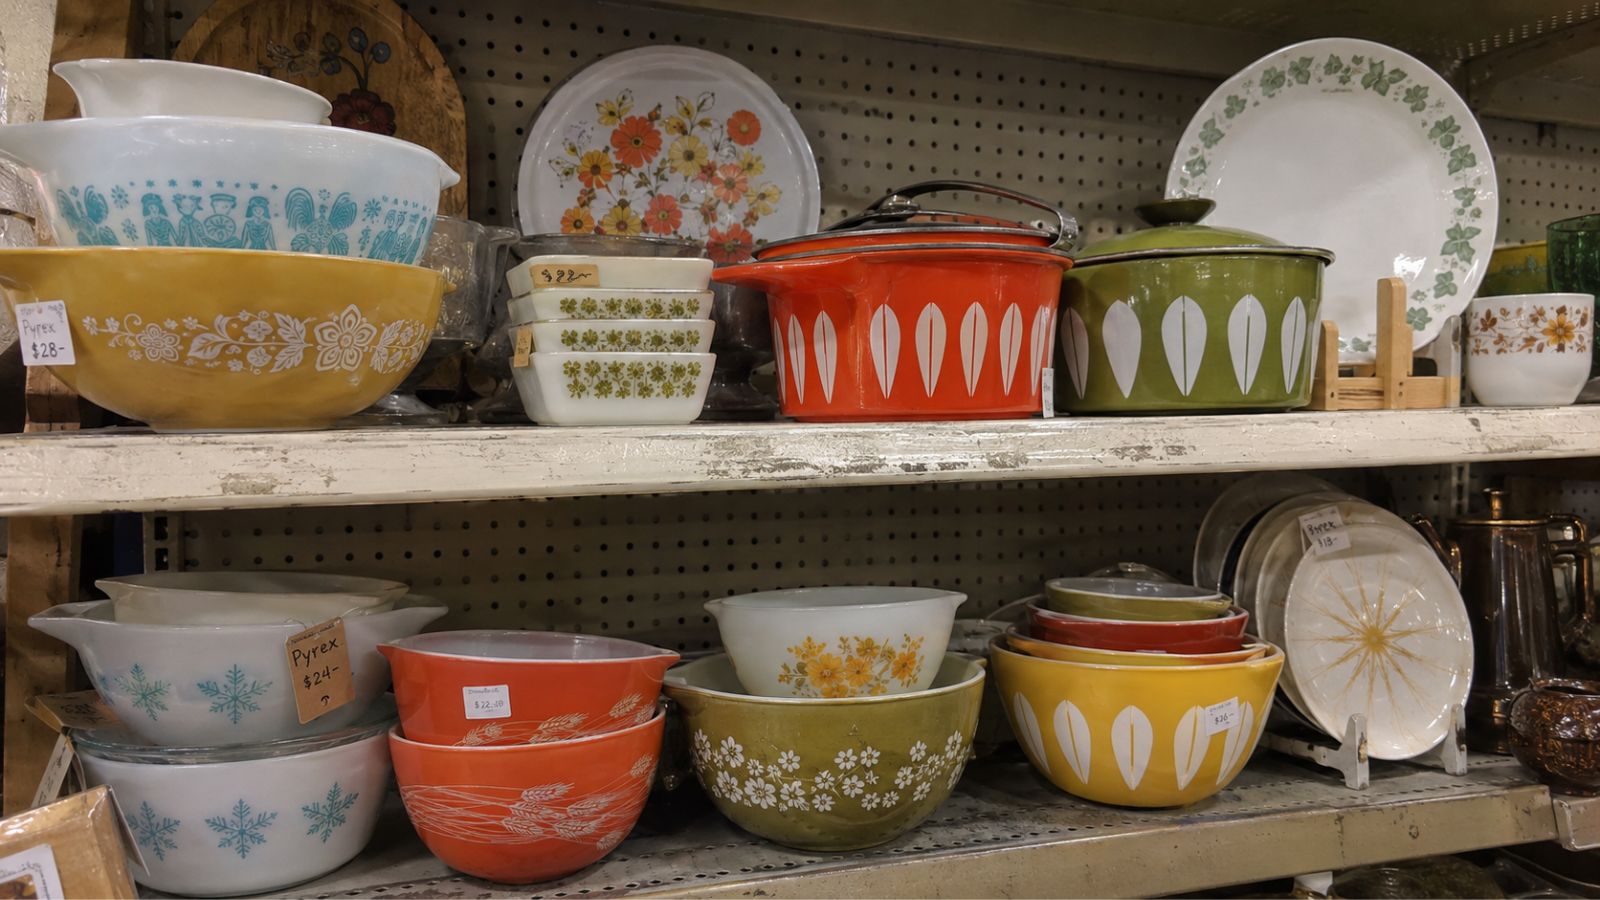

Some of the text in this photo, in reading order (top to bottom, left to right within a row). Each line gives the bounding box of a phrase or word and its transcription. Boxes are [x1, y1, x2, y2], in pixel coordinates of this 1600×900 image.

[22, 319, 56, 339] Pyrex
[32, 341, 65, 359] $28-
[292, 638, 339, 668] Pyrex
[303, 665, 339, 690] $24-
